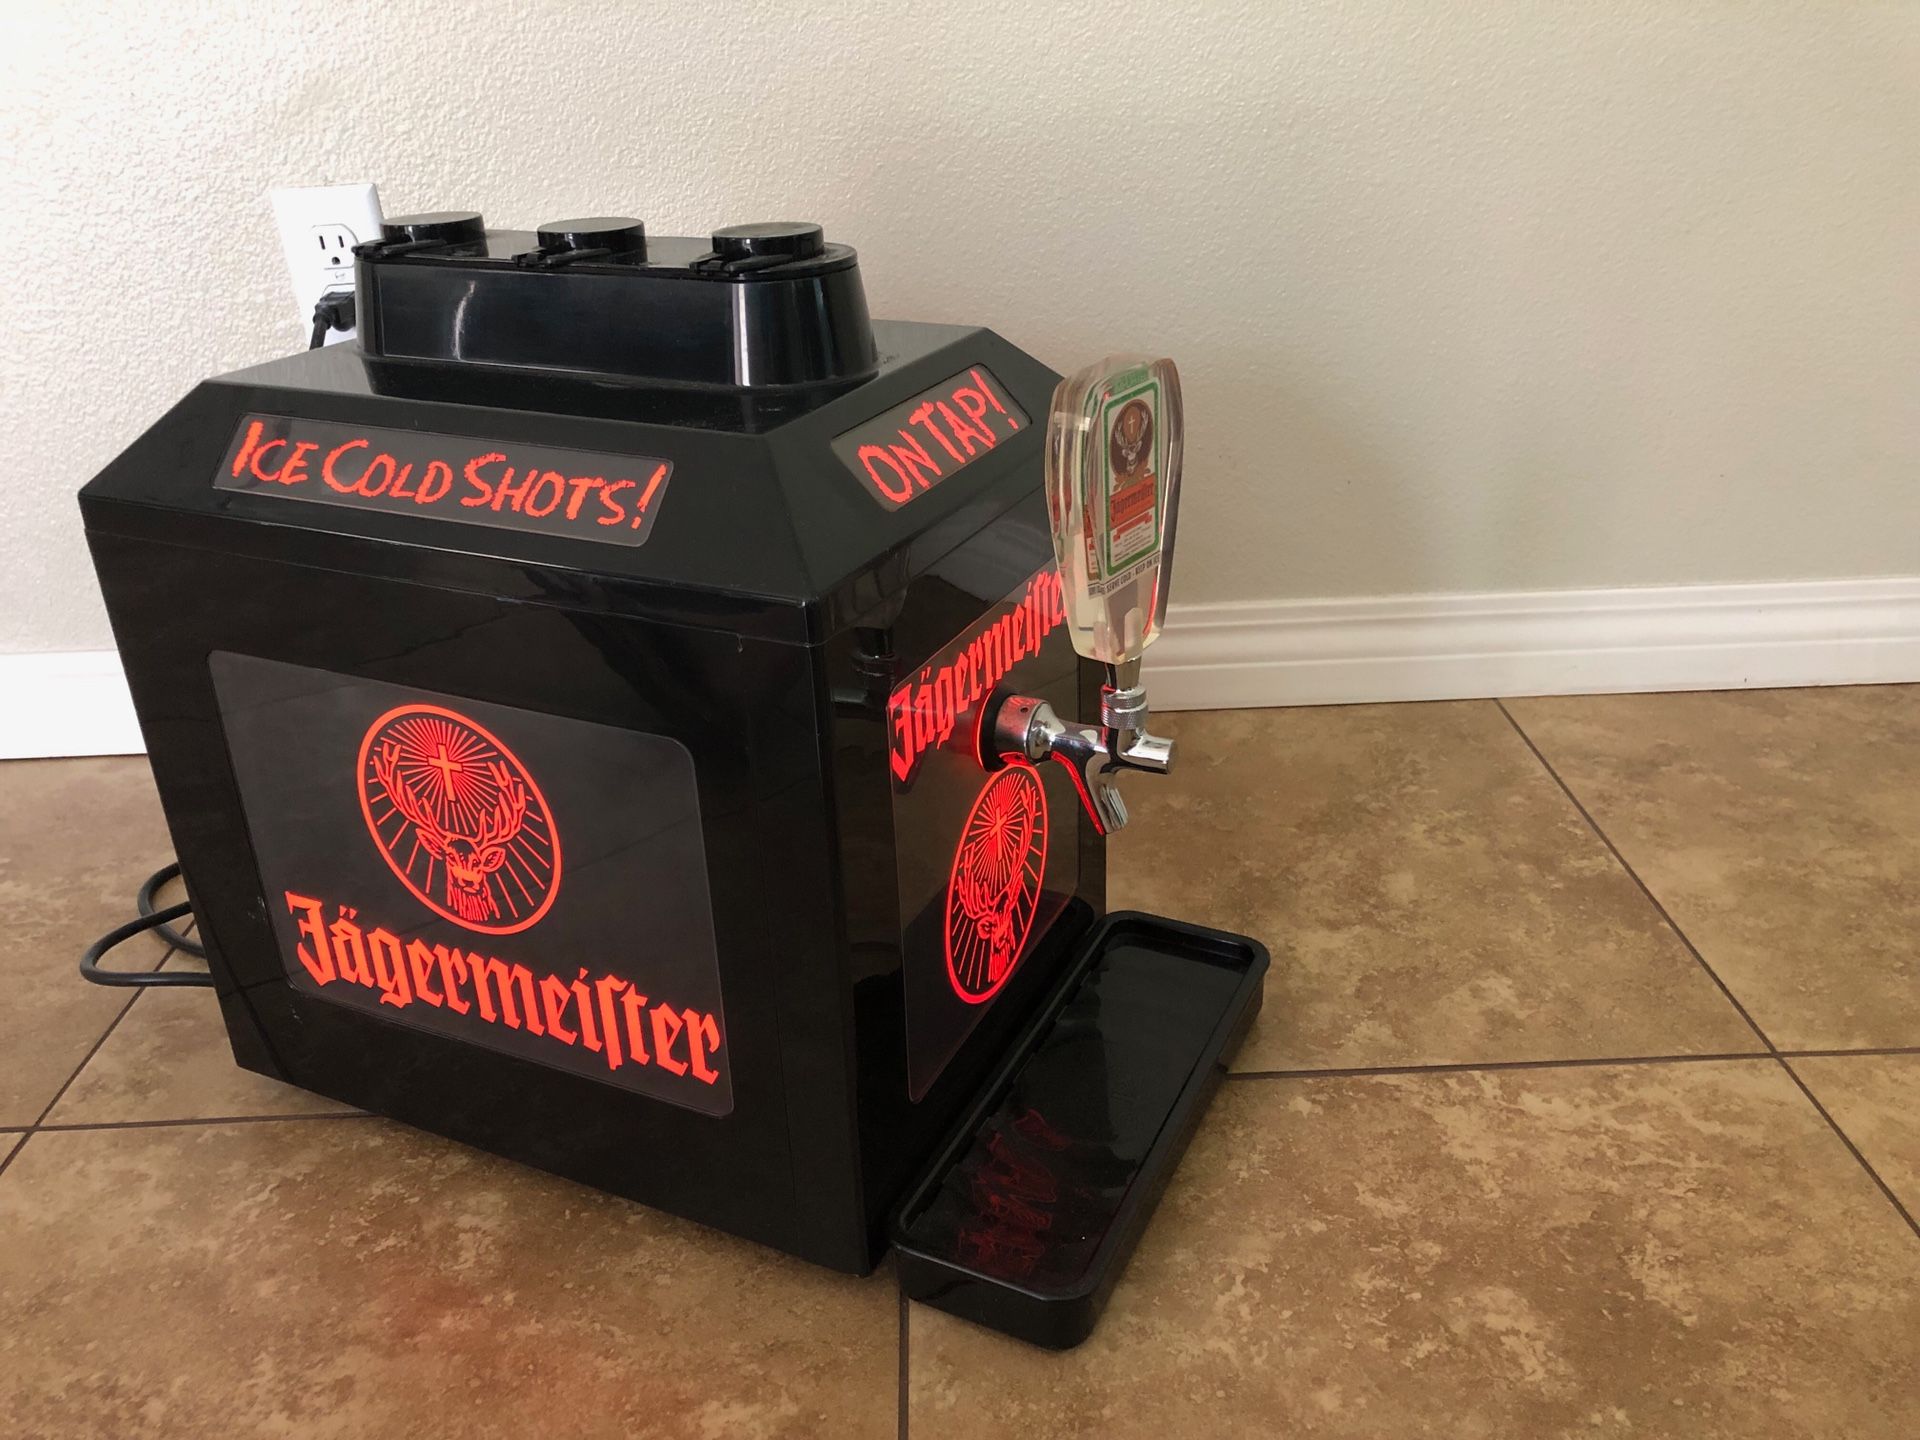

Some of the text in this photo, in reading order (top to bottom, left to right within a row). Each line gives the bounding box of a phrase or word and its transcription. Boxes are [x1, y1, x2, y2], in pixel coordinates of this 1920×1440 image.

[231, 420, 667, 530] ICE COLD SHOTS!
[857, 369, 1019, 504] ON TAP!
[888, 570, 1068, 783] Jägermeiste
